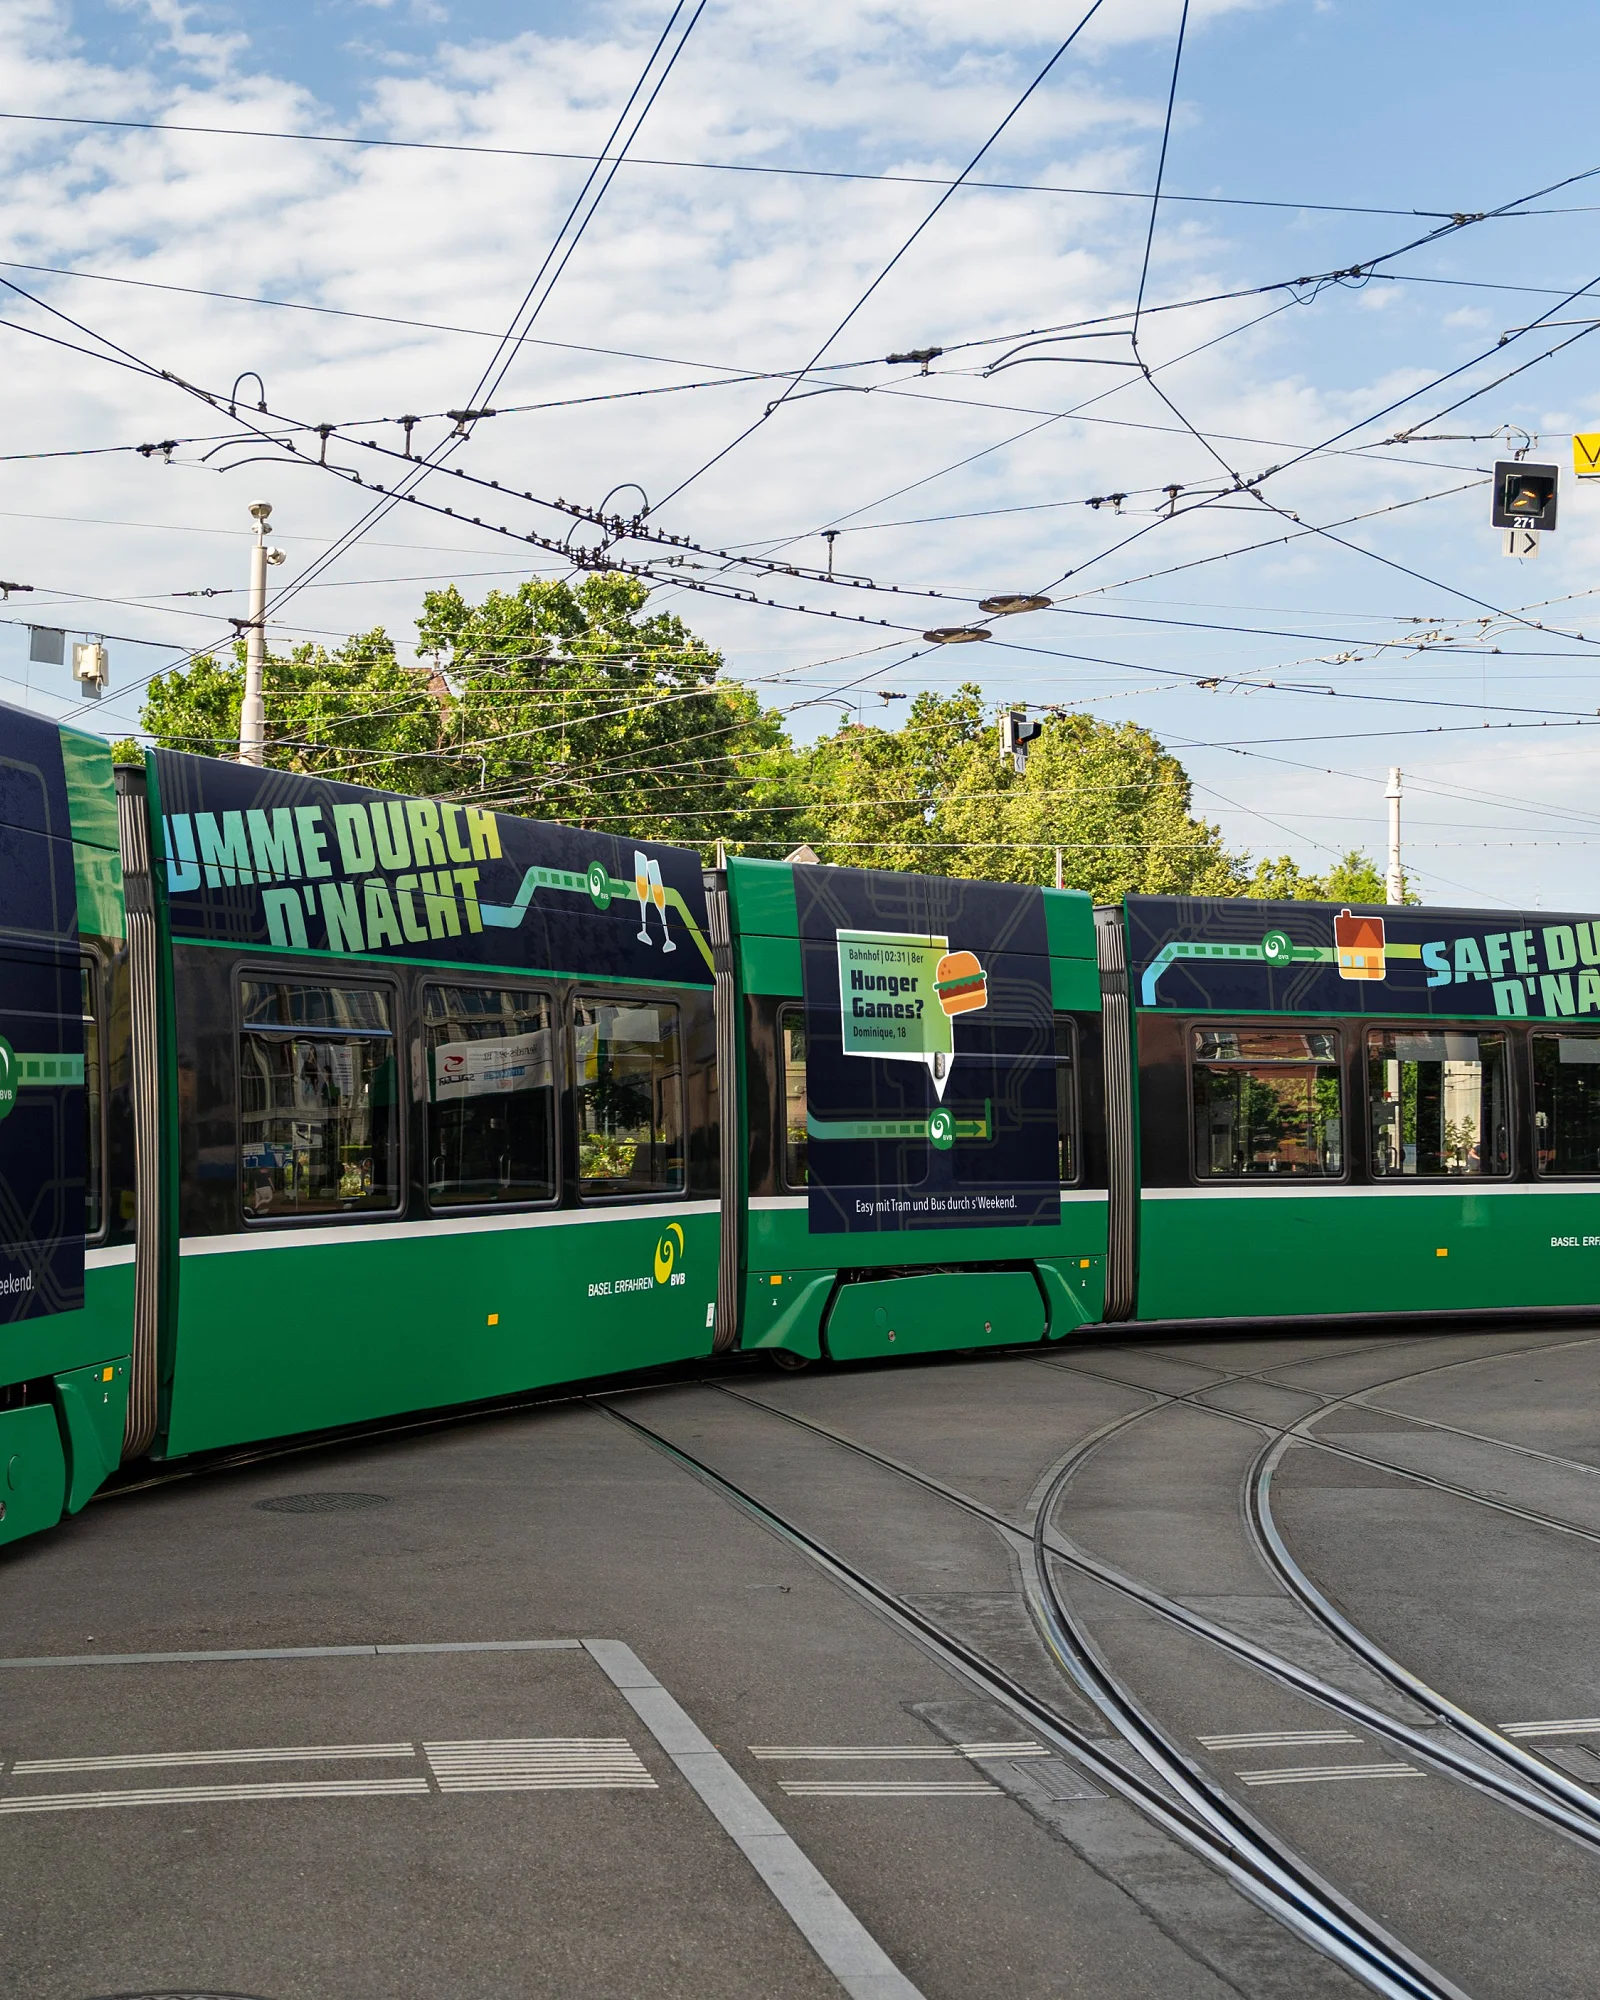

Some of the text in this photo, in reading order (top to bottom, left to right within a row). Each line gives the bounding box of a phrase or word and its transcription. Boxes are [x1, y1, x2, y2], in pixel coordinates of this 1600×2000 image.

[1513, 516, 1535, 529] 271
[162, 799, 503, 893] UMME DURCH
[262, 867, 484, 952] D'NACHT
[849, 948, 880, 961] Bahnhof
[884, 951, 906, 963] 02:31
[911, 952, 924, 964] 8er
[1421, 929, 1538, 988] SAFE
[850, 969, 919, 997] Hunger
[852, 997, 924, 1020] Games?
[853, 1026, 907, 1041] Dominique, 18
[856, 1195, 1018, 1216] Easy mit Tram und Bus durch s'Weekend.
[1550, 1236, 1600, 1247] BASEL ERF
[588, 1276, 654, 1297] BASEL ERFAHREN
[670, 1272, 686, 1286] BVB
